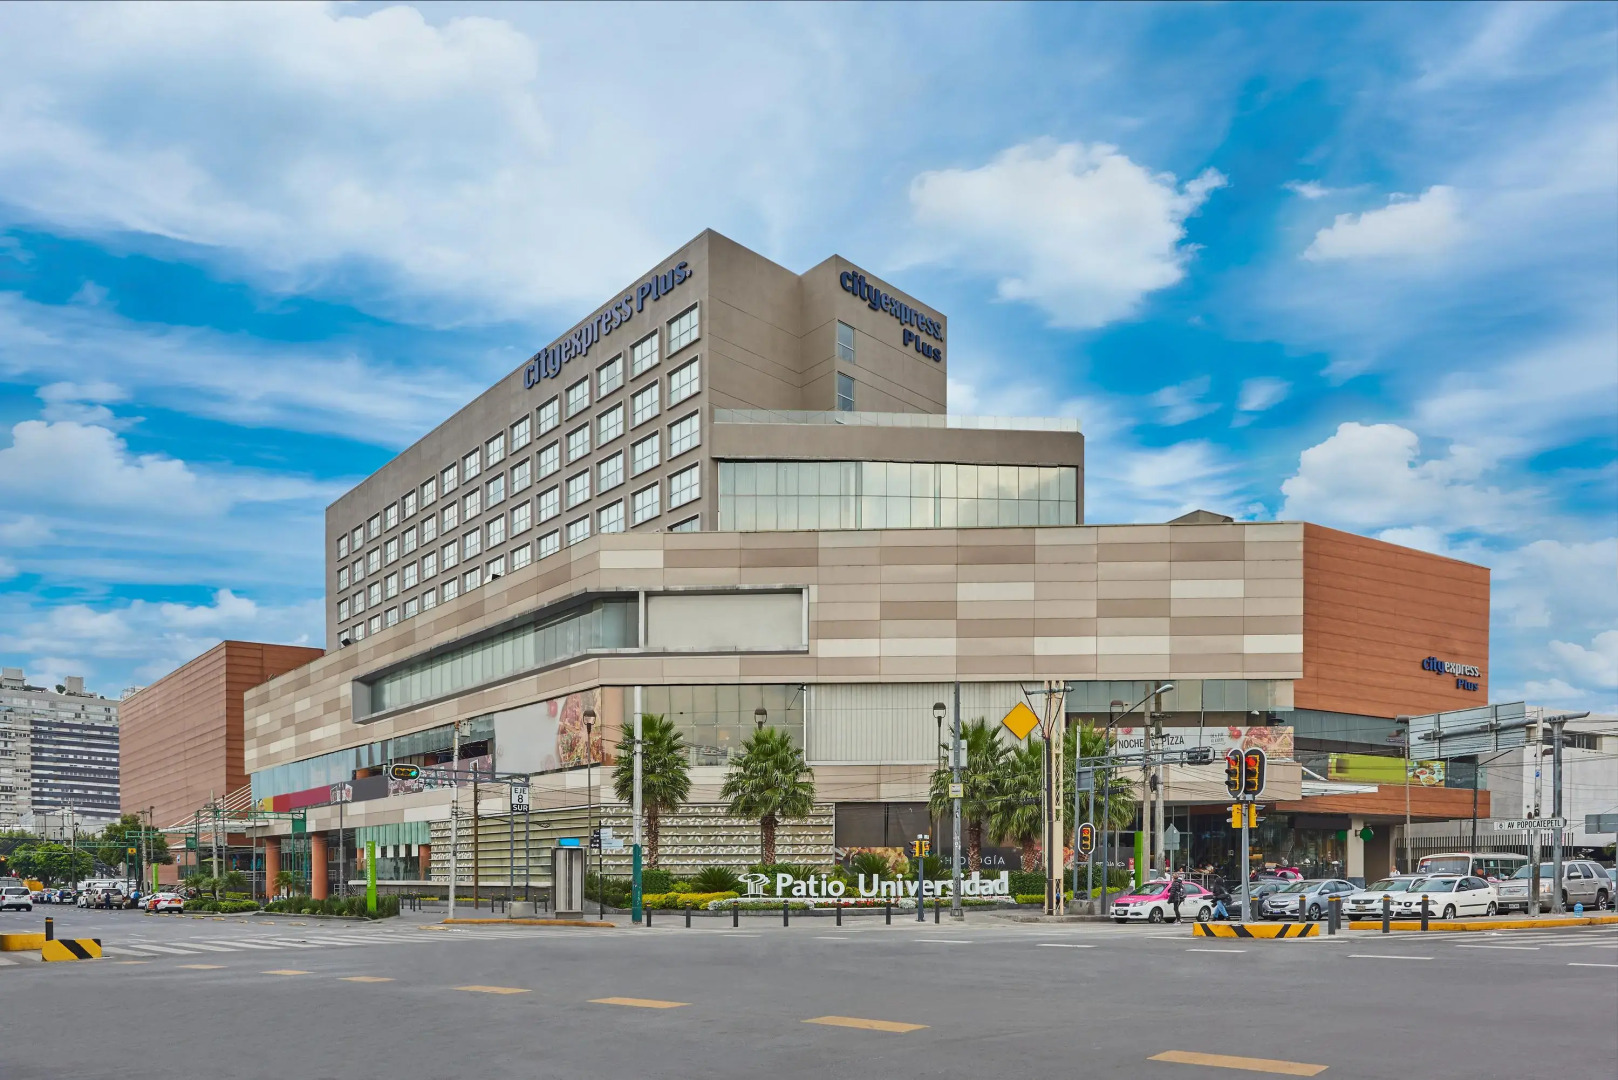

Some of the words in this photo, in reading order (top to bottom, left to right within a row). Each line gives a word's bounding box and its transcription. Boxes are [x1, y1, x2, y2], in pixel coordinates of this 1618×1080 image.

[523, 294, 633, 390] cityexpress
[903, 328, 942, 362] Plus
[1456, 678, 1479, 691] Plus
[1118, 738, 1144, 749] NOCHE
[1161, 735, 1185, 746] PIZZA
[517, 794, 524, 803] 8
[1507, 821, 1515, 829] AV
[1516, 819, 1561, 829] POPOCATEPETL
[776, 873, 845, 897] Patio
[858, 870, 1009, 897] Universidad
